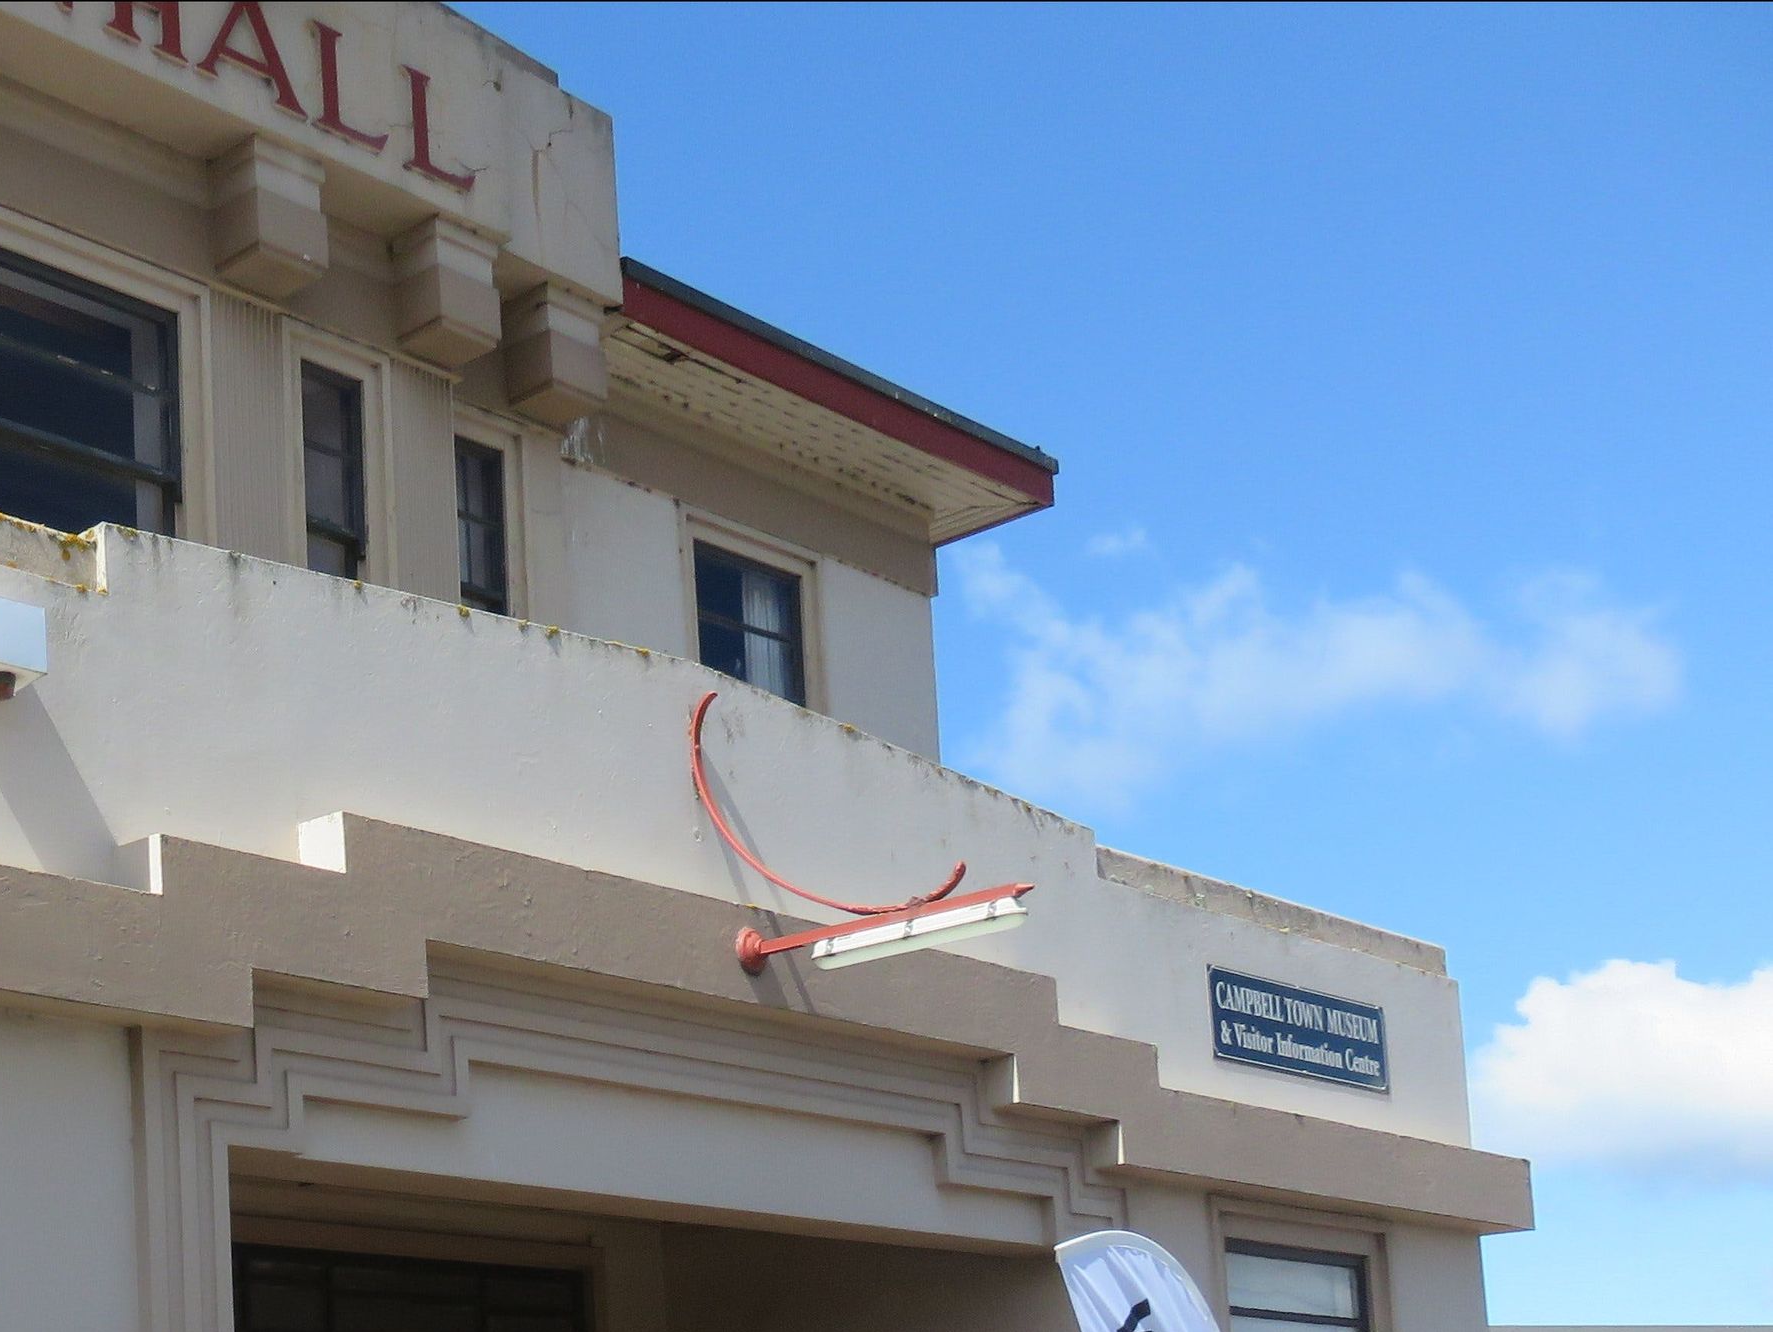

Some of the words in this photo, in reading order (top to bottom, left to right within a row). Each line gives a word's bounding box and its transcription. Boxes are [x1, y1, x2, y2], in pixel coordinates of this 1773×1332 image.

[1215, 981, 1284, 1022] CAMPBELL
[1284, 998, 1324, 1033] TOWN
[1326, 1007, 1380, 1044] MUSEUM
[1220, 1020, 1233, 1045] &
[1233, 1022, 1274, 1054] Visitor
[1275, 1032, 1343, 1069] Information
[1345, 1048, 1381, 1077] Centre
